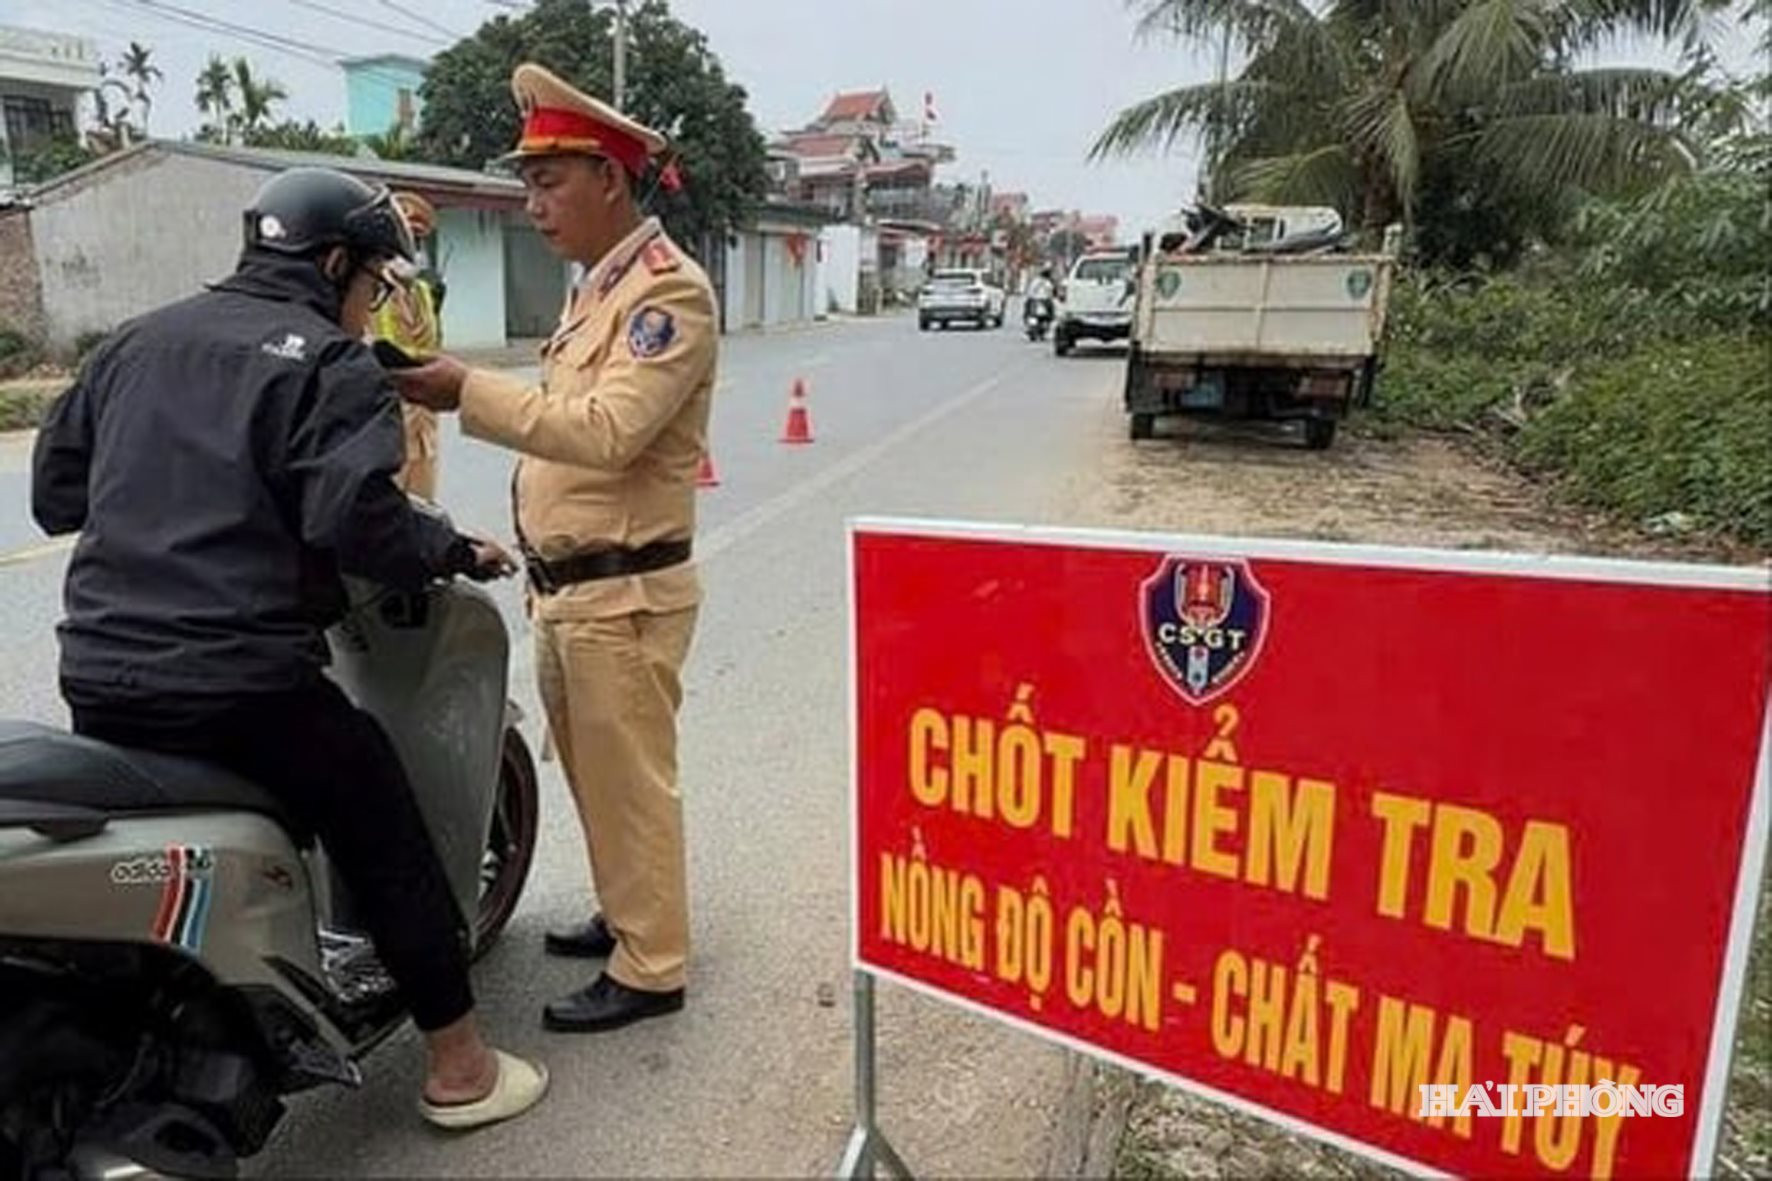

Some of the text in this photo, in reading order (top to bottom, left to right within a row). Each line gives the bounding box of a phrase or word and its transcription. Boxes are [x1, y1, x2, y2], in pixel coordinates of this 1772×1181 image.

[1159, 622, 1245, 650] CSGT
[910, 683, 1575, 960] CHỐT KIỂM TRA
[881, 826, 985, 971] NỒNG
[996, 875, 1052, 1011] ĐỘ
[1066, 878, 1163, 1032] CỒN
[1210, 934, 1360, 1094] CHẤT
[1370, 995, 1473, 1140] MA
[1500, 1023, 1643, 1181] TÚY
